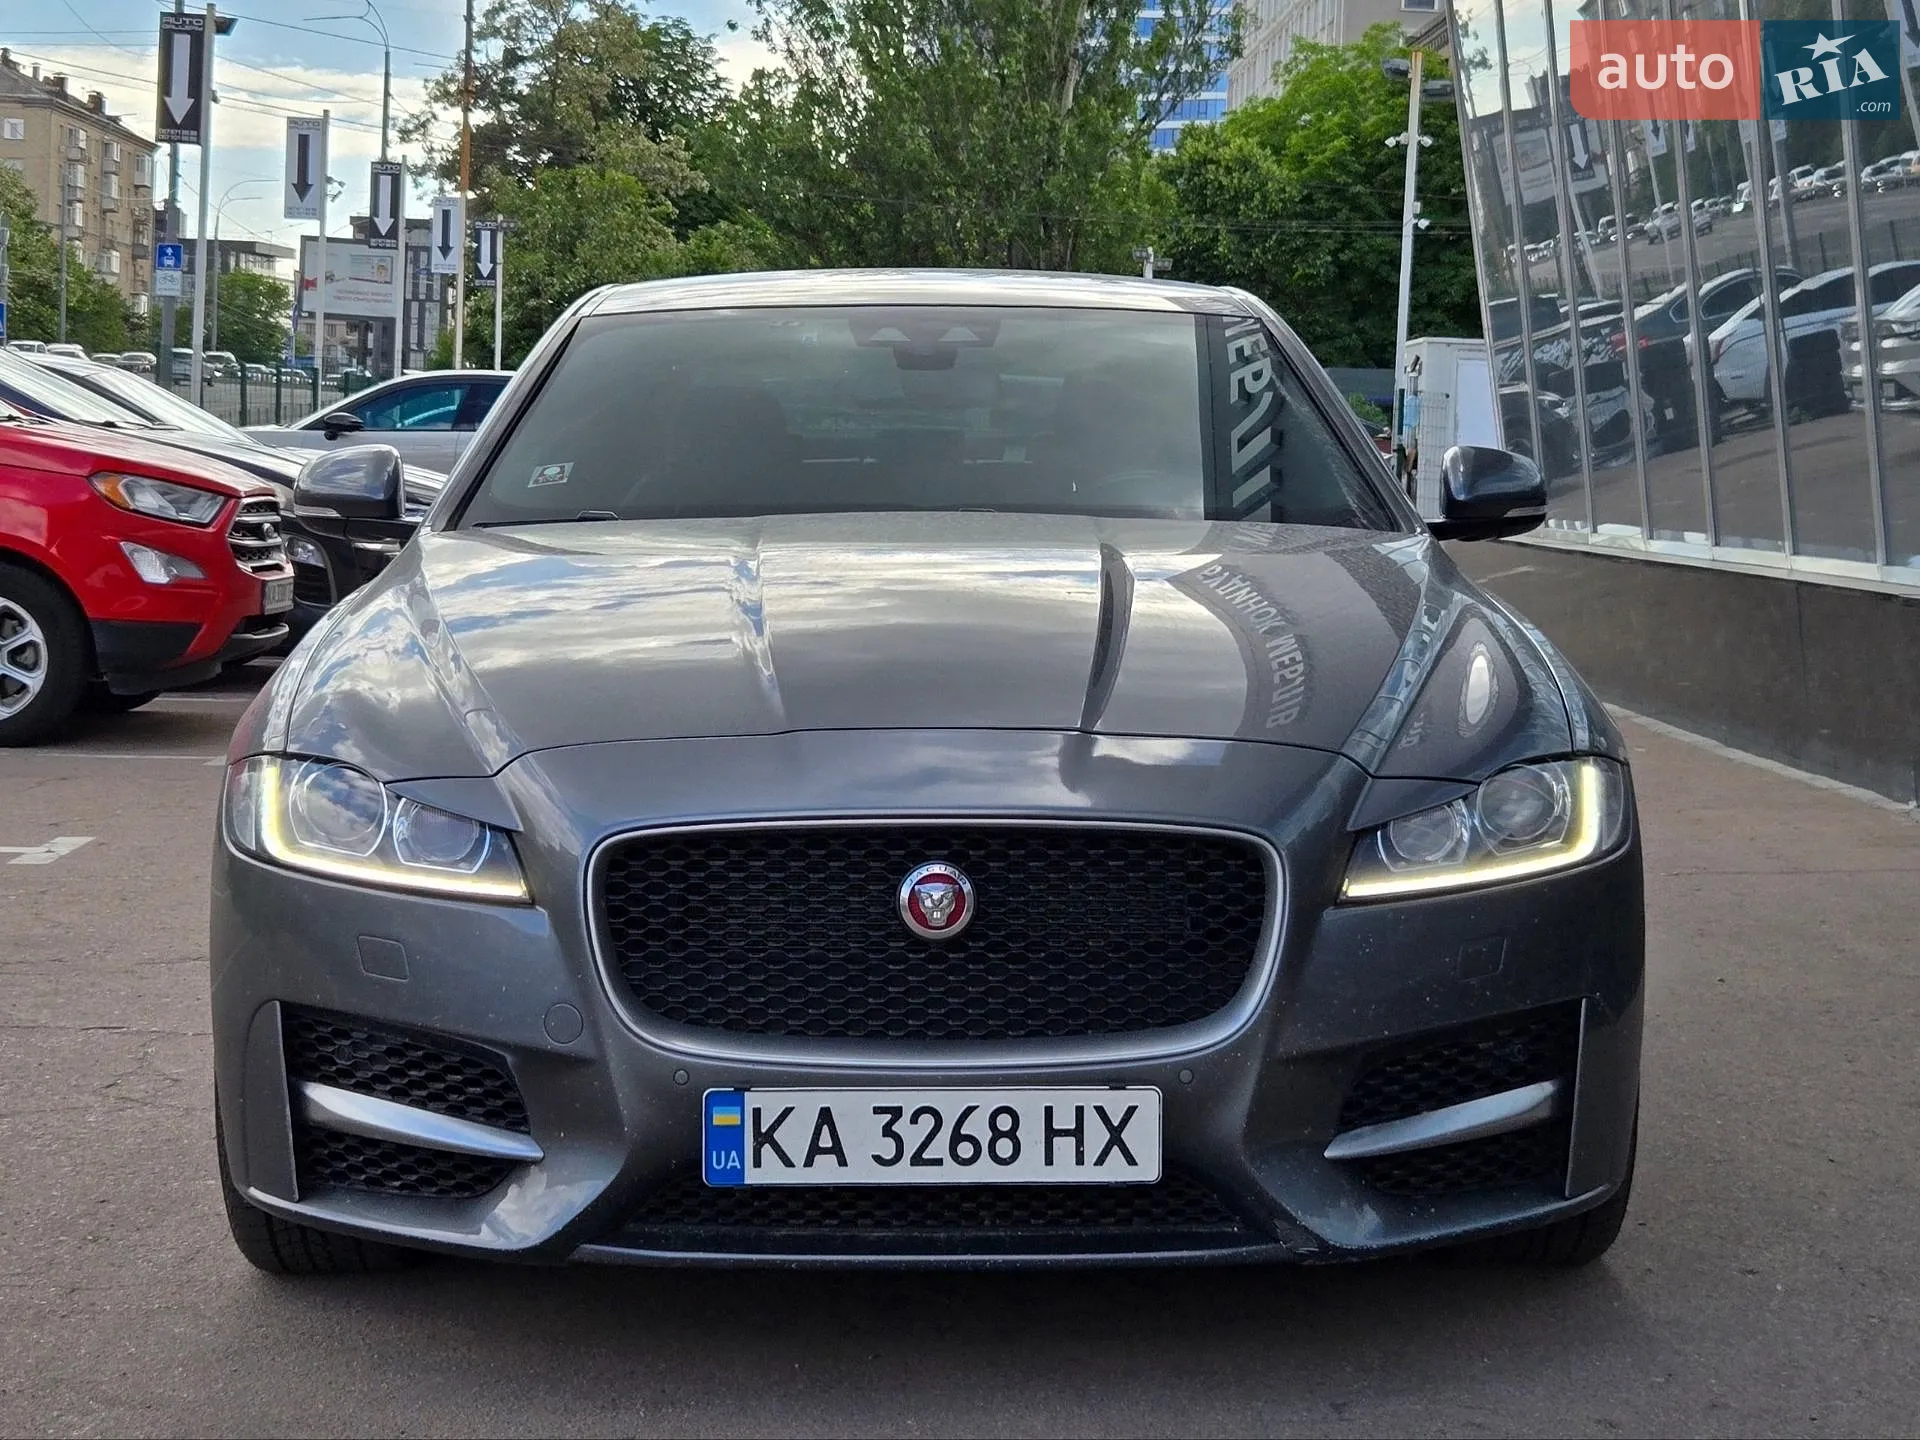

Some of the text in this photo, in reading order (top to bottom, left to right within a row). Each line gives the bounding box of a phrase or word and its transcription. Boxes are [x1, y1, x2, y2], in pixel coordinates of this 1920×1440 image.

[163, 16, 203, 26] AUTO
[372, 163, 400, 171] AUTO
[907, 865, 967, 886] JAGUAR
[752, 1105, 1139, 1168] KA 3268 HX
[713, 1150, 742, 1170] UA
